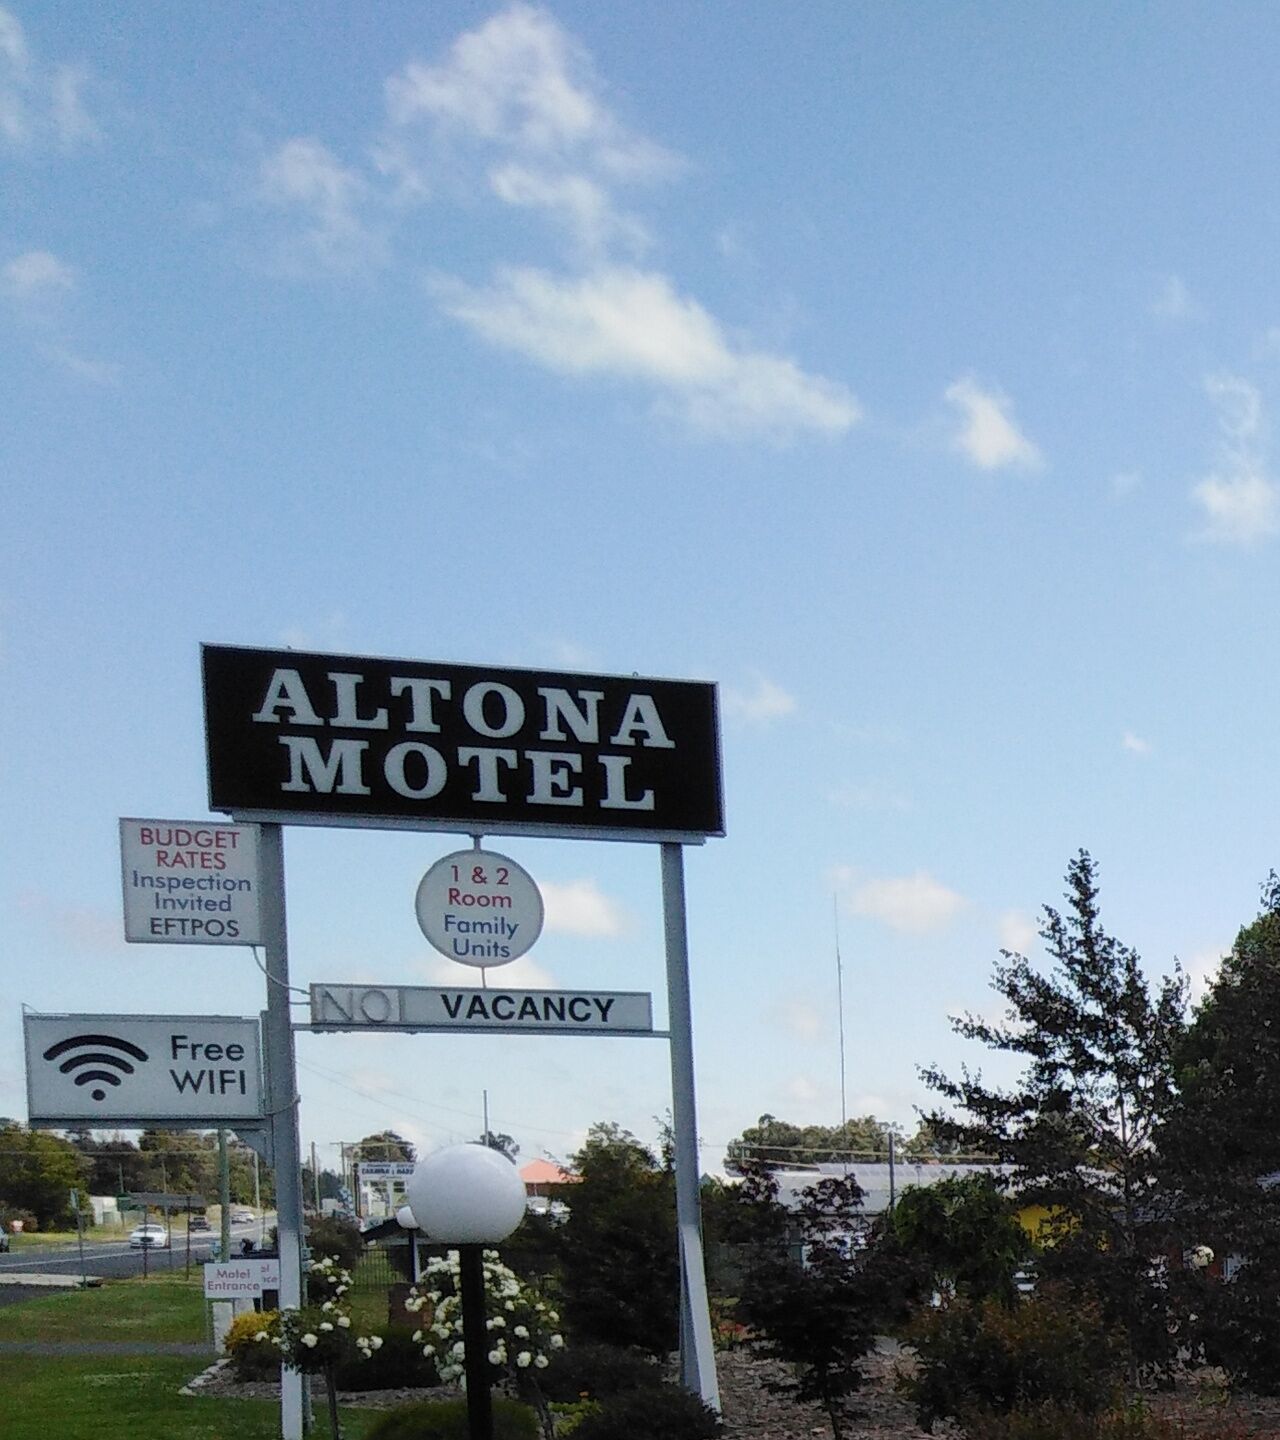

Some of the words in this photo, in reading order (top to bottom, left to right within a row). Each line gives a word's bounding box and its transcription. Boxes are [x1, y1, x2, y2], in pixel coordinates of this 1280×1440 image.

[252, 668, 676, 749] ALTONA
[278, 736, 656, 811] MOTEL
[140, 827, 240, 849] BUDGET
[156, 850, 226, 870] RATES
[133, 870, 252, 894] Inspection
[451, 865, 459, 882] 1
[471, 866, 487, 885] &
[496, 867, 509, 885] 2
[155, 892, 232, 912] Invited
[448, 888, 512, 908] Room
[150, 917, 240, 937] EFTPOS
[444, 914, 519, 940] Family
[453, 938, 511, 958] Units
[321, 989, 391, 1023] NO
[440, 993, 615, 1023] VACANCY
[170, 1035, 245, 1061] Free
[169, 1069, 246, 1095] WIFI
[217, 1268, 250, 1279] Motel
[207, 1281, 260, 1291] Entrance
